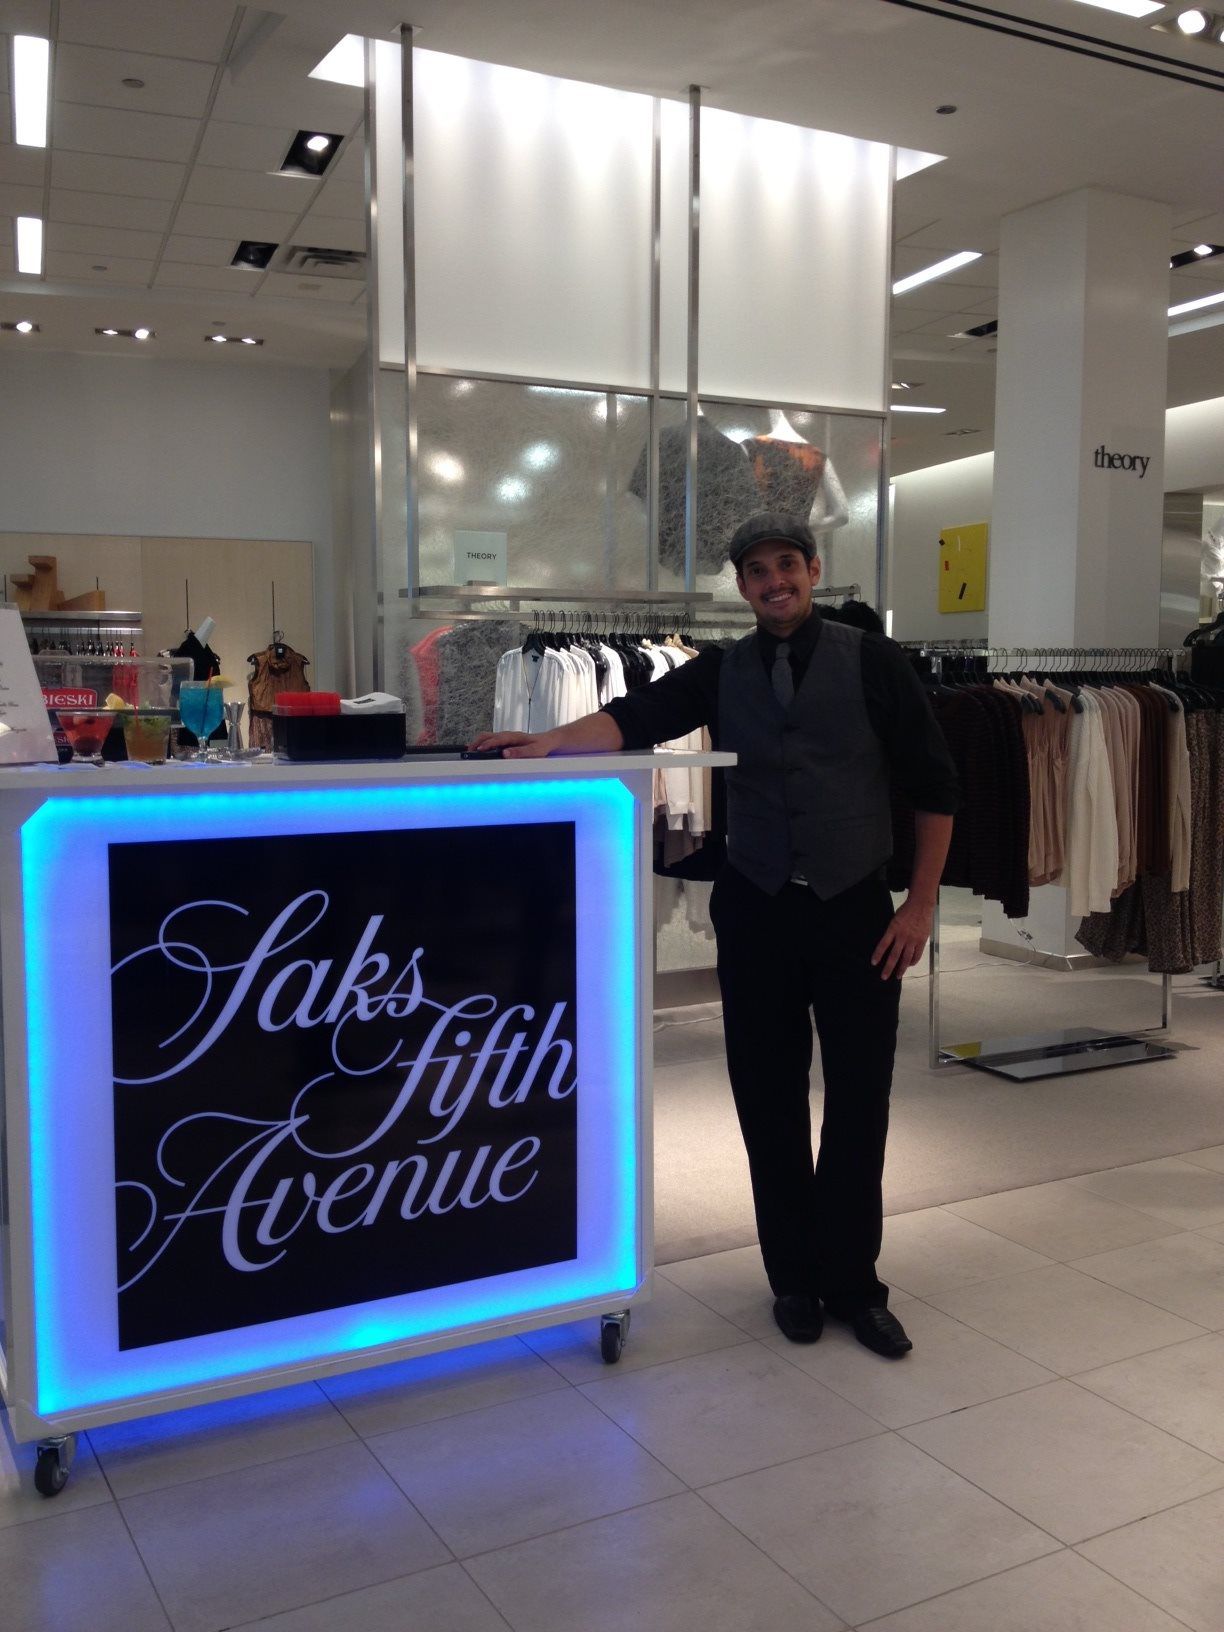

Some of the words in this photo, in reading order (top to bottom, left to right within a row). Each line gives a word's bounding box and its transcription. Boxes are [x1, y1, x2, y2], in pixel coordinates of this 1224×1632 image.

[1094, 445, 1150, 478] theory
[466, 552, 497, 560] THEORY
[110, 889, 424, 1085] Saks
[115, 1111, 542, 1293] Avenue
